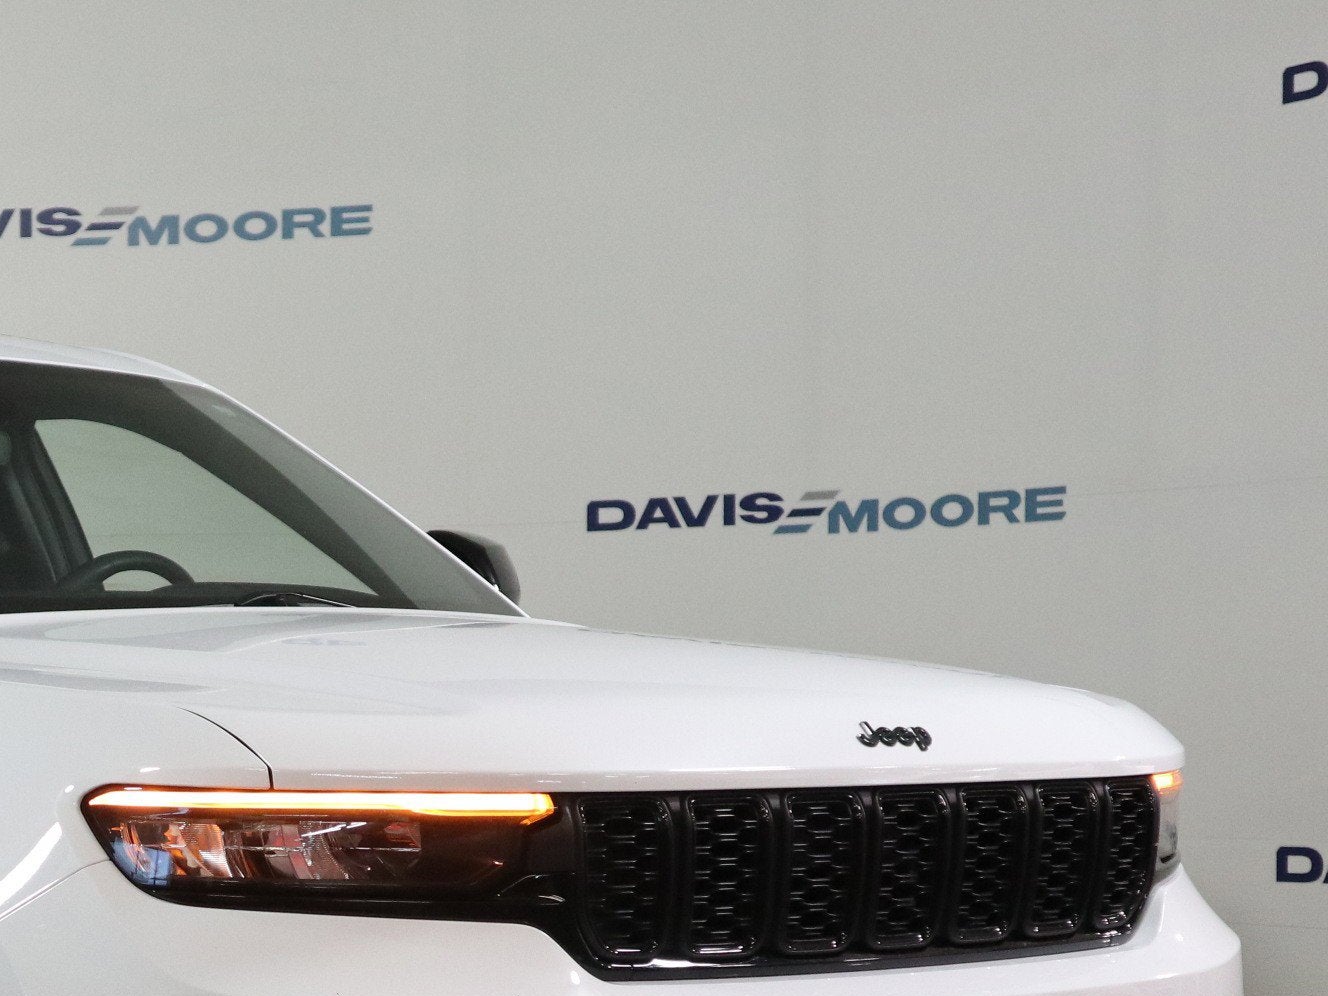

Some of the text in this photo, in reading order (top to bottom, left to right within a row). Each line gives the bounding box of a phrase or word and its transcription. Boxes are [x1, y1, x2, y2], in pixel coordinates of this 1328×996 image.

[127, 203, 374, 247] MOORE
[586, 485, 1067, 535] DAVIS MOORE
[856, 720, 932, 752] Jeep
[1276, 846, 1328, 884] D
